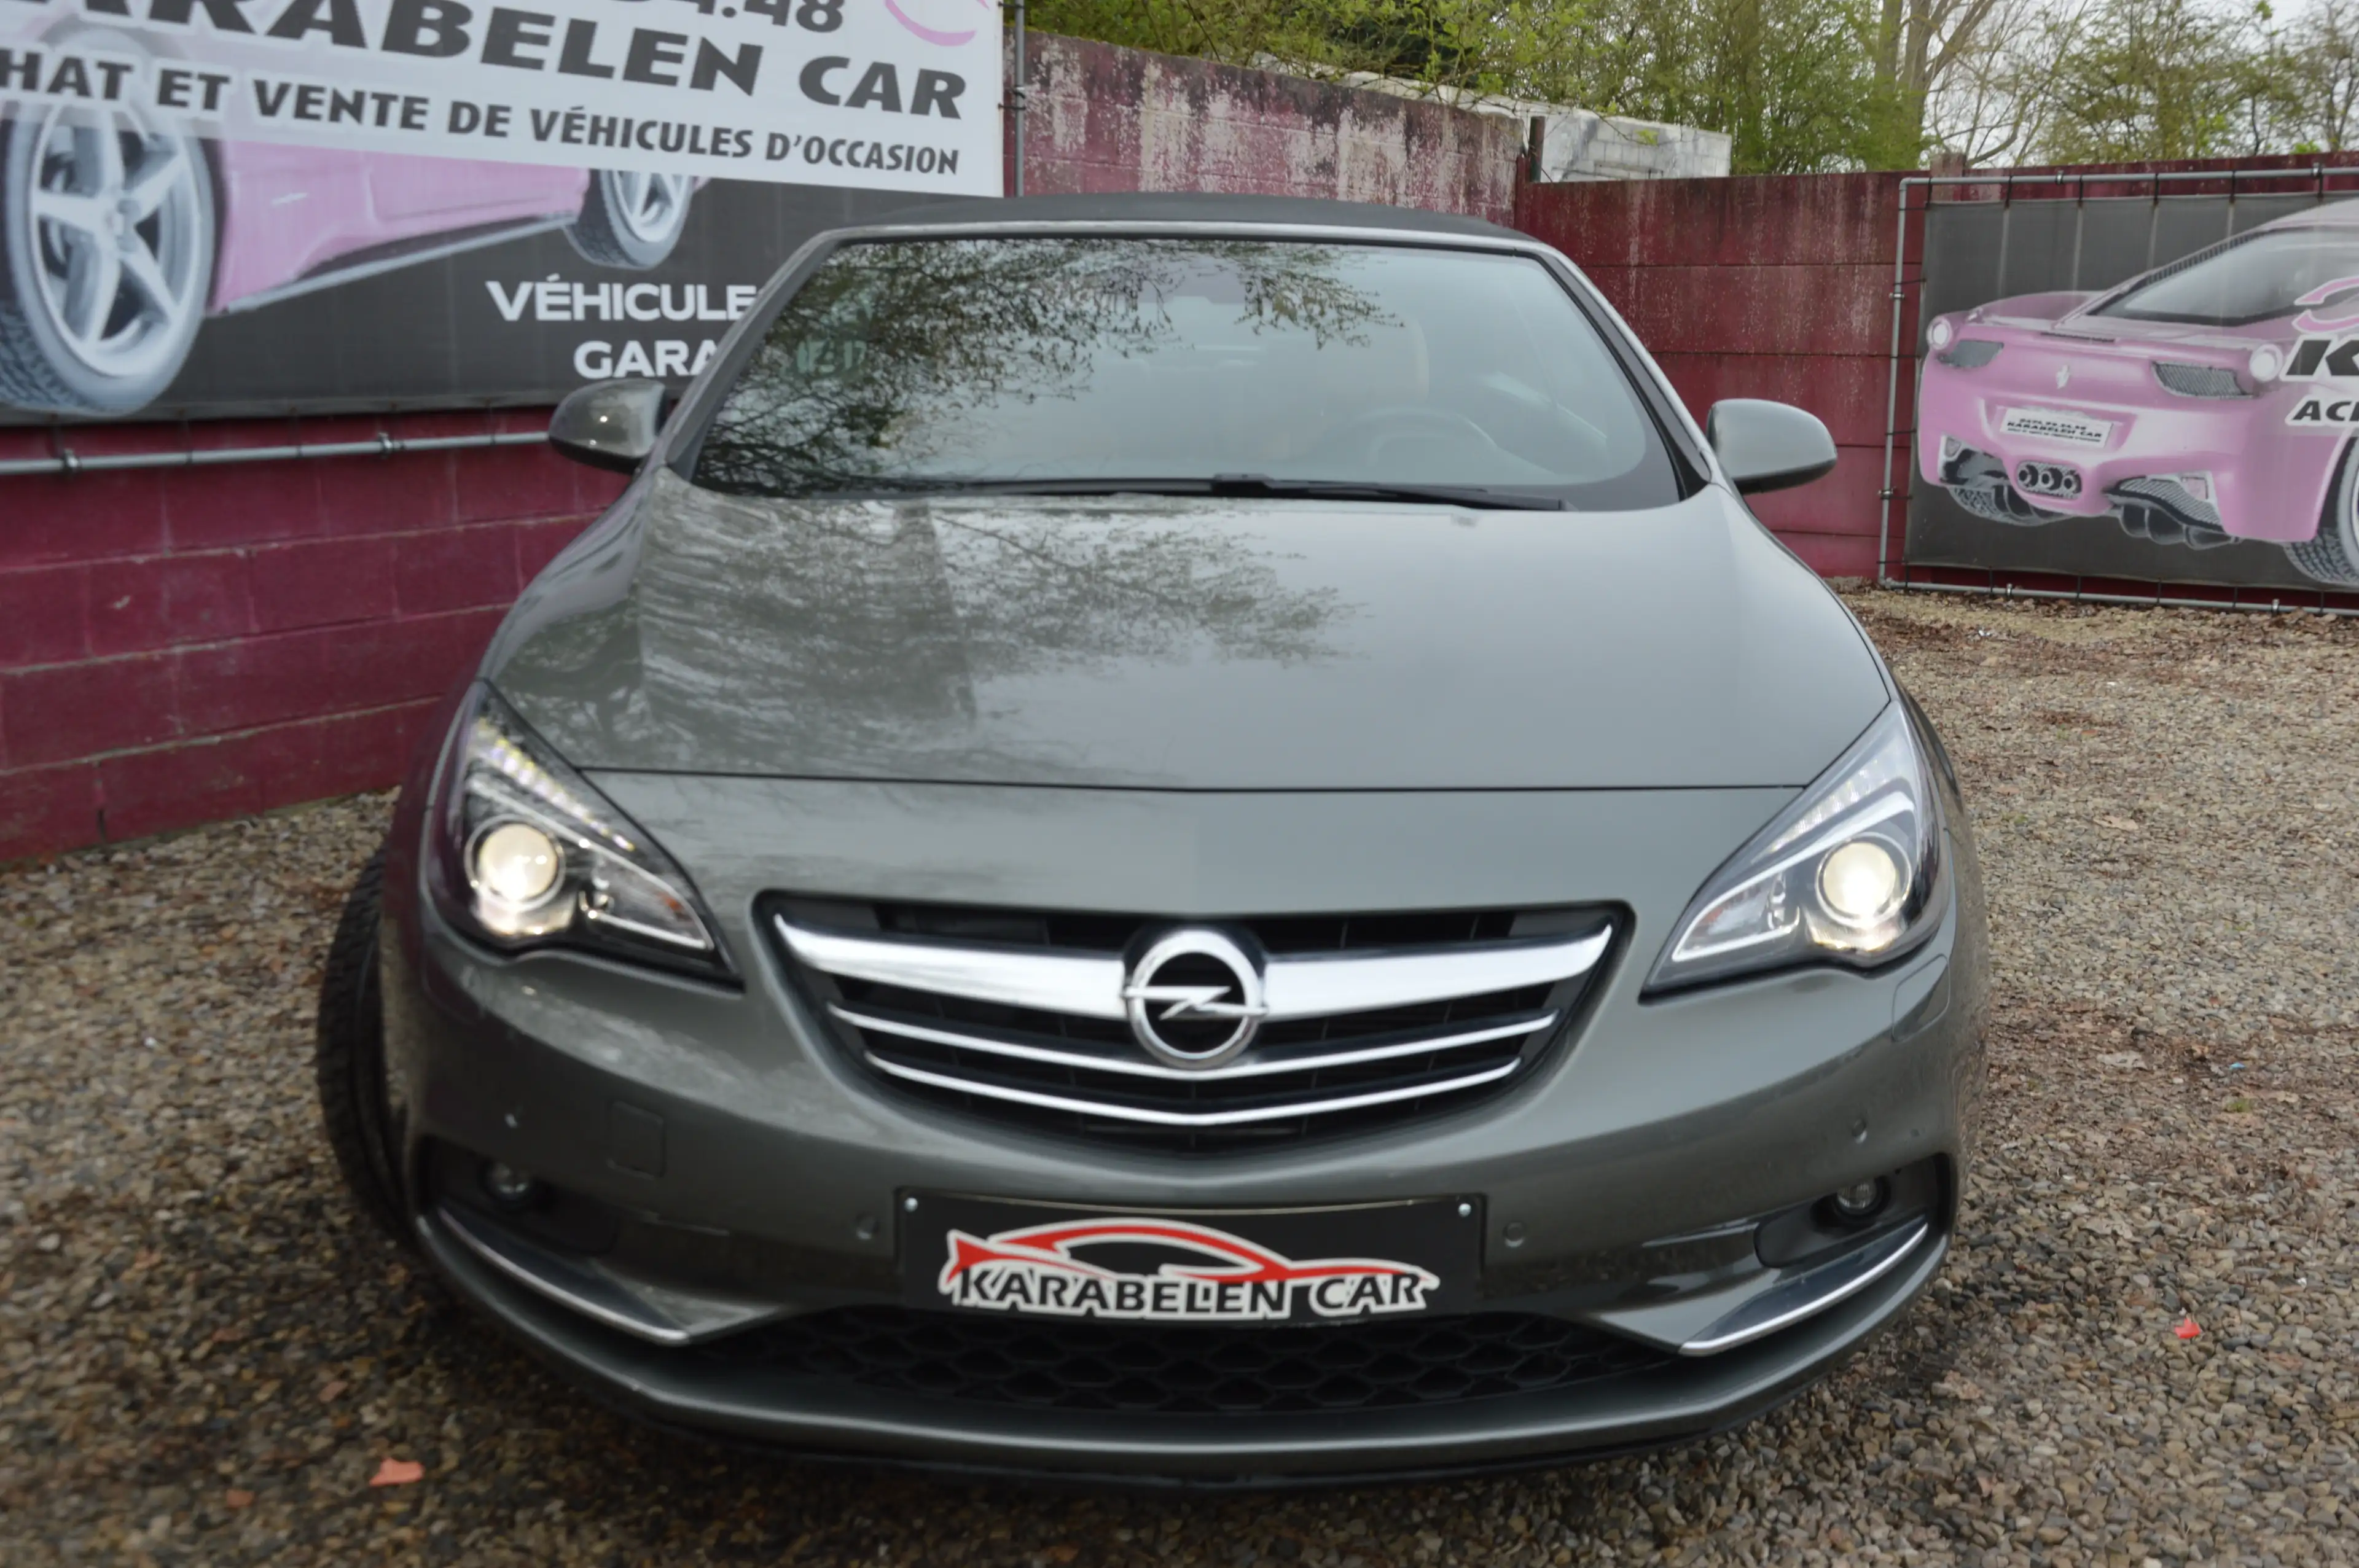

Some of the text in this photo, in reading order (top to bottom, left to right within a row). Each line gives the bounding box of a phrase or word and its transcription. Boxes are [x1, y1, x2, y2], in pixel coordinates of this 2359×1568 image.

[157, 68, 231, 111] ET
[254, 79, 429, 130] VENTE
[447, 101, 512, 138] DE
[530, 105, 754, 158] VÉHICULES
[799, 55, 966, 120] CAR
[958, 1267, 1423, 1315] KARABELEN CAR
